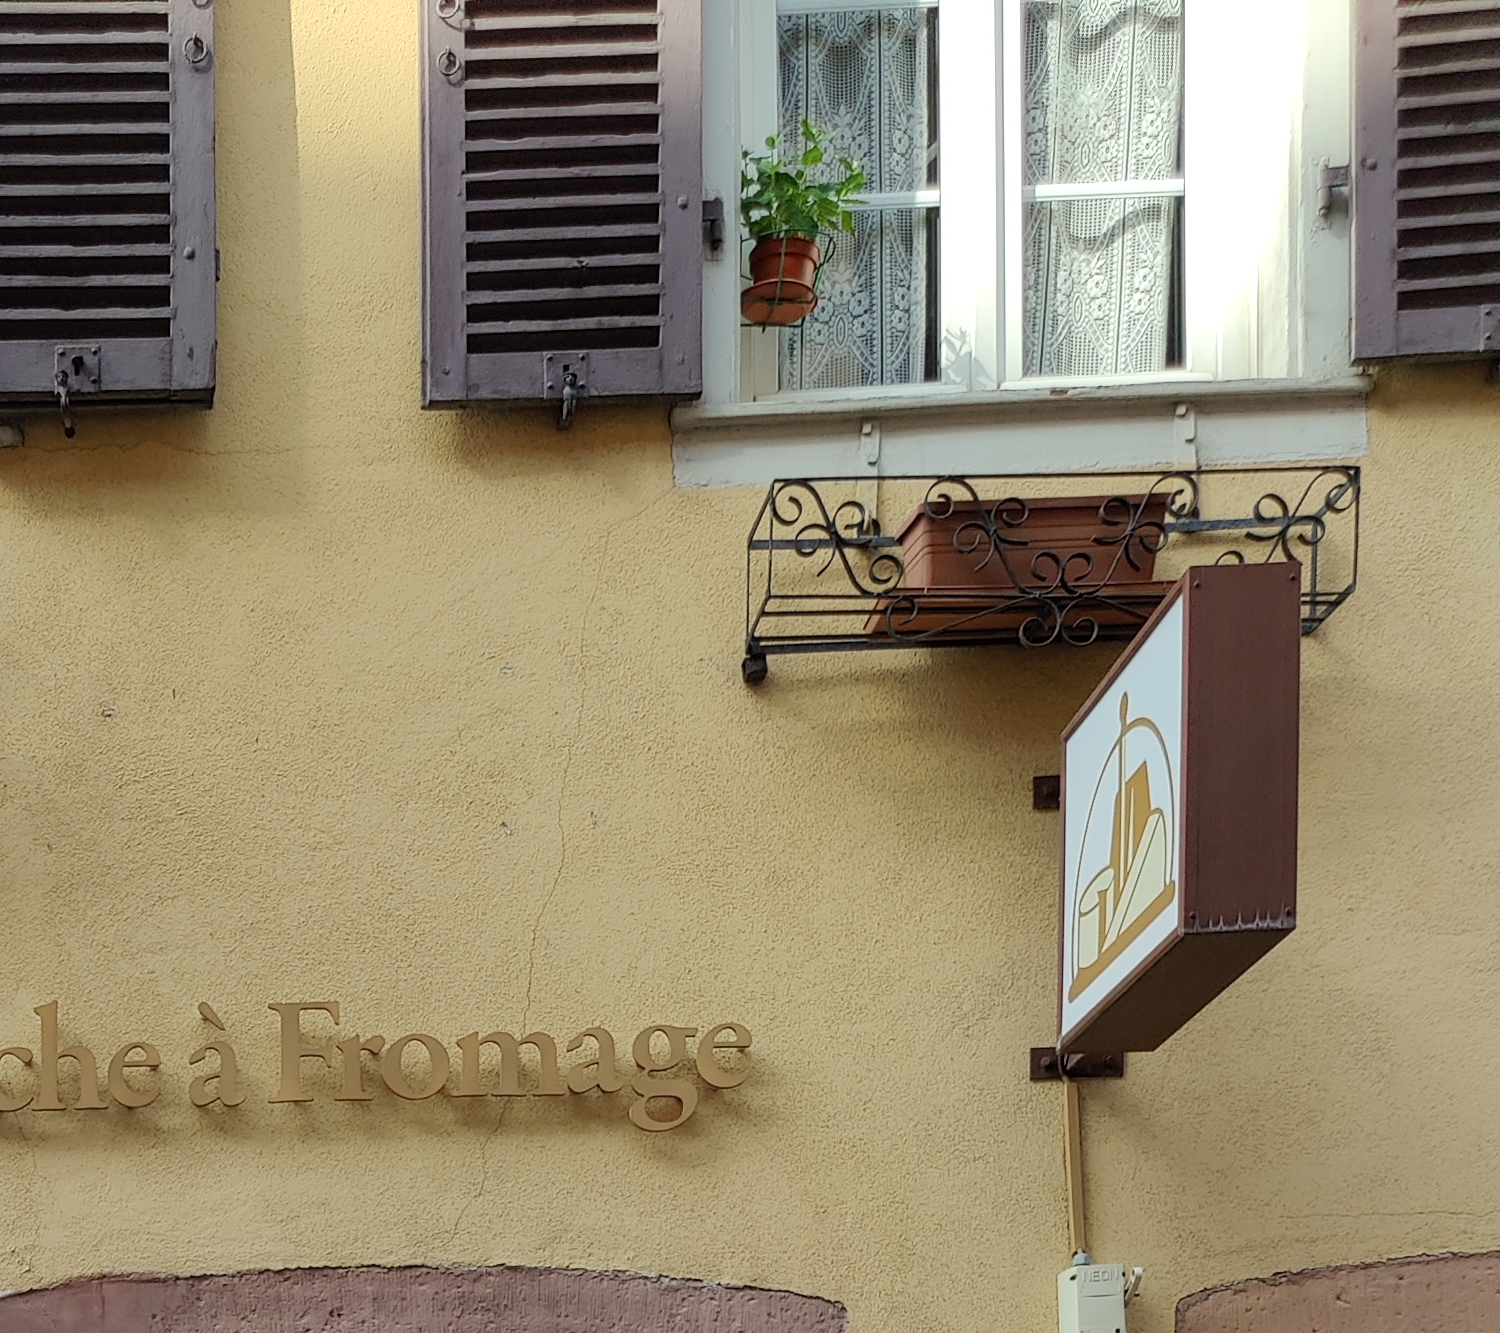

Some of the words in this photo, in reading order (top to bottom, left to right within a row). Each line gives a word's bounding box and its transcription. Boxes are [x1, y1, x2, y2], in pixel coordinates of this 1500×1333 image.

[189, 1002, 247, 1107] à
[268, 1001, 752, 1132] Fromage
[1081, 1268, 1119, 1283] NEON
